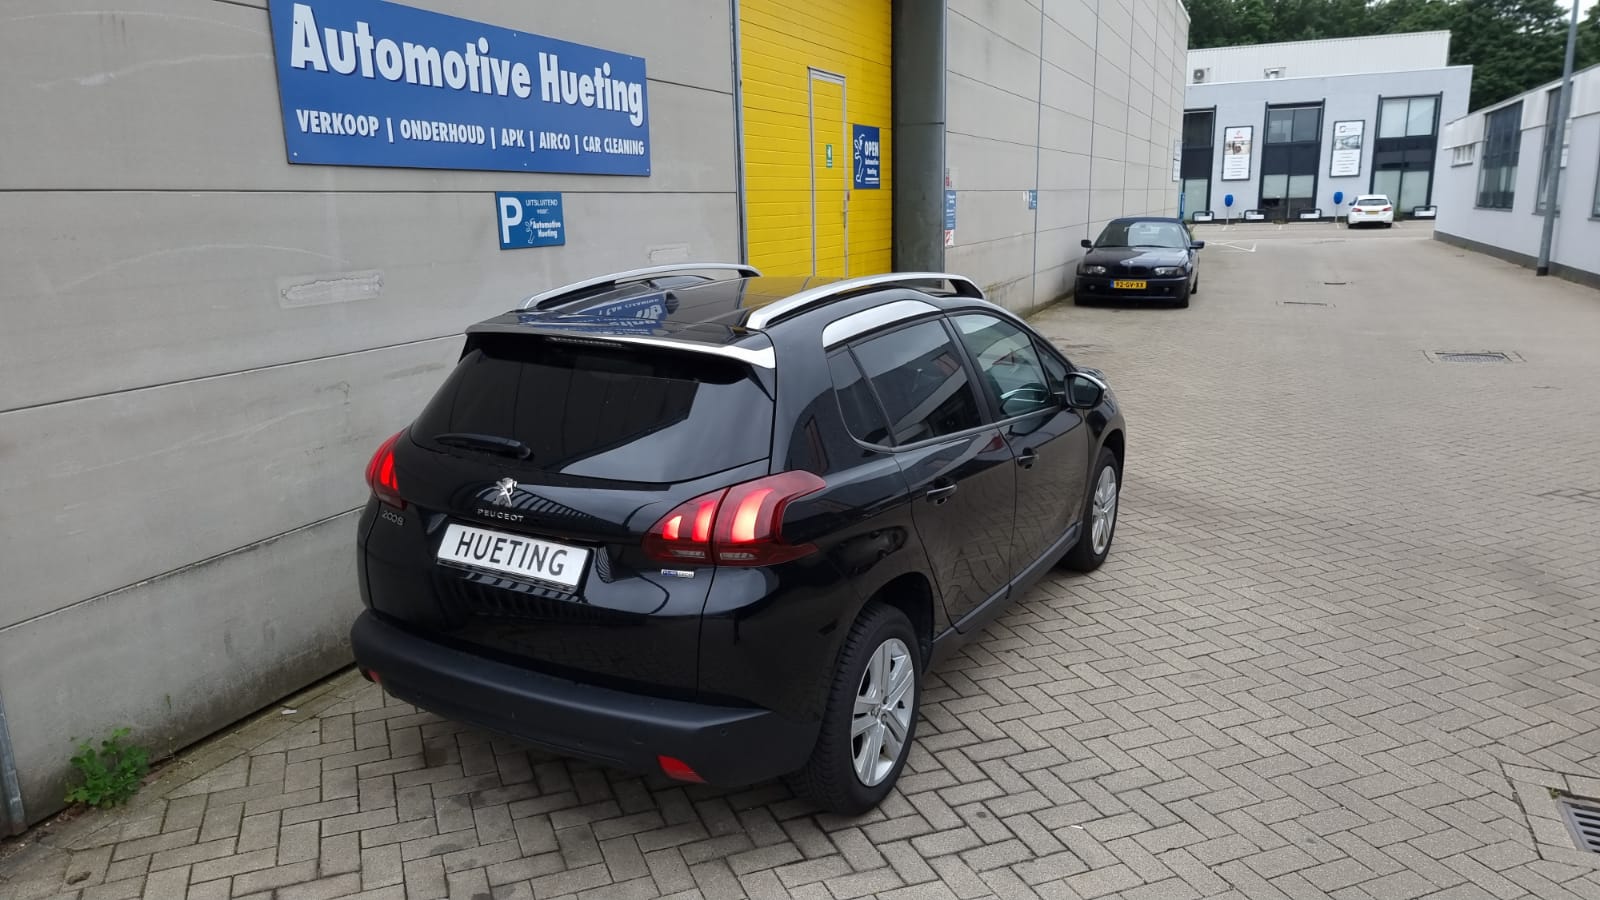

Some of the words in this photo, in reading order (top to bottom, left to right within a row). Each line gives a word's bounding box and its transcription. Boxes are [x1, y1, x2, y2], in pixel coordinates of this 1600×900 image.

[290, 3, 531, 99] Automotive
[538, 51, 643, 126] Hueting
[296, 109, 379, 137] VERKOOP
[400, 119, 485, 145] ONDERHOUD
[501, 128, 525, 147] APK
[539, 131, 570, 150] AIRCO
[582, 136, 601, 153] CAR
[604, 138, 645, 155] CLEANING
[864, 141, 879, 157] OPEN
[500, 197, 523, 243] P
[381, 509, 404, 526] 2008
[477, 508, 524, 522] PEUGEOT
[455, 531, 568, 576] HUETING
